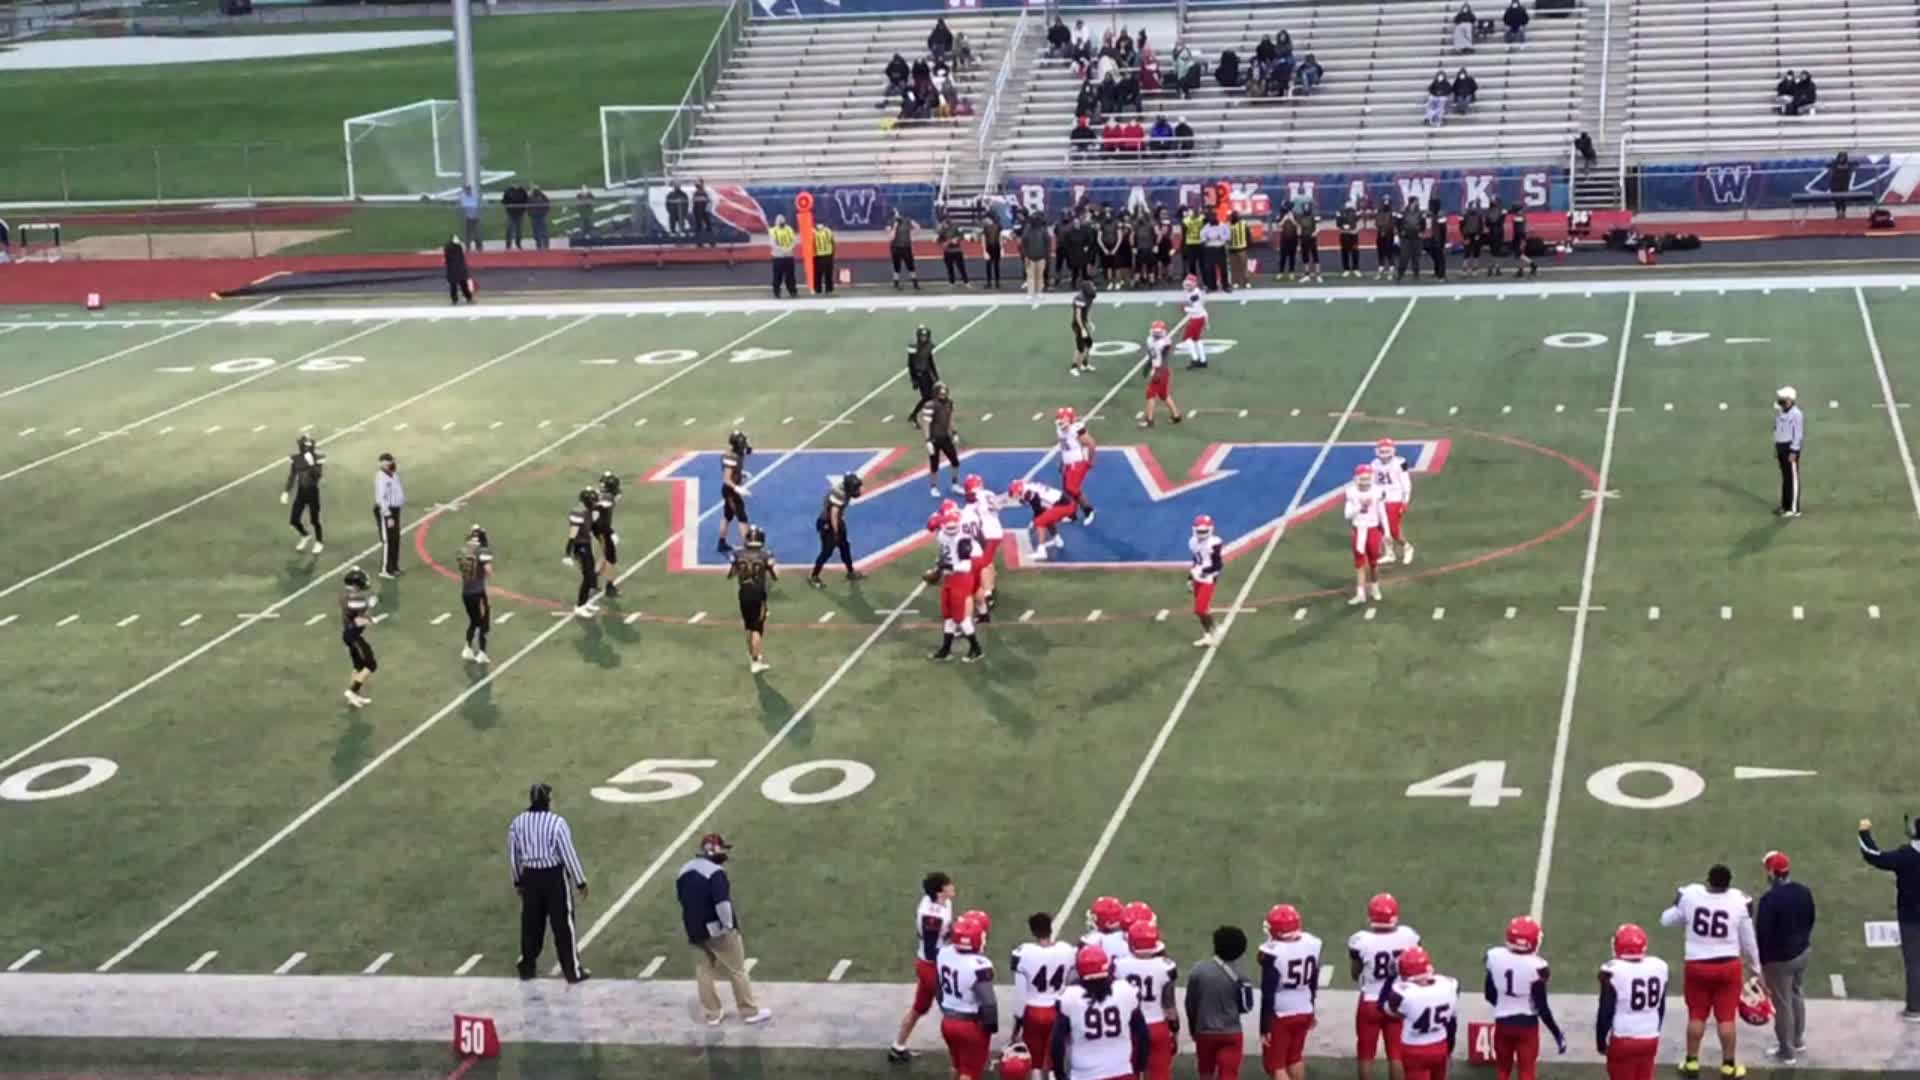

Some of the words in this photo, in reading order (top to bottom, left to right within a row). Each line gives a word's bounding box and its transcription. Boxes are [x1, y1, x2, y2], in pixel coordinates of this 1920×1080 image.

[1706, 165, 1752, 202] W
[834, 189, 876, 225] W
[590, 758, 876, 804] 50
[1404, 760, 1707, 808] 40
[1692, 906, 1729, 938] 66
[940, 964, 963, 999] 61
[1031, 964, 1066, 993] 44
[1283, 954, 1317, 989] 50
[1504, 969, 1517, 997] 1
[1630, 976, 1661, 1011] 68
[1083, 1004, 1121, 1041] 99
[1411, 1002, 1451, 1035] 45
[460, 1020, 485, 1055] 50
